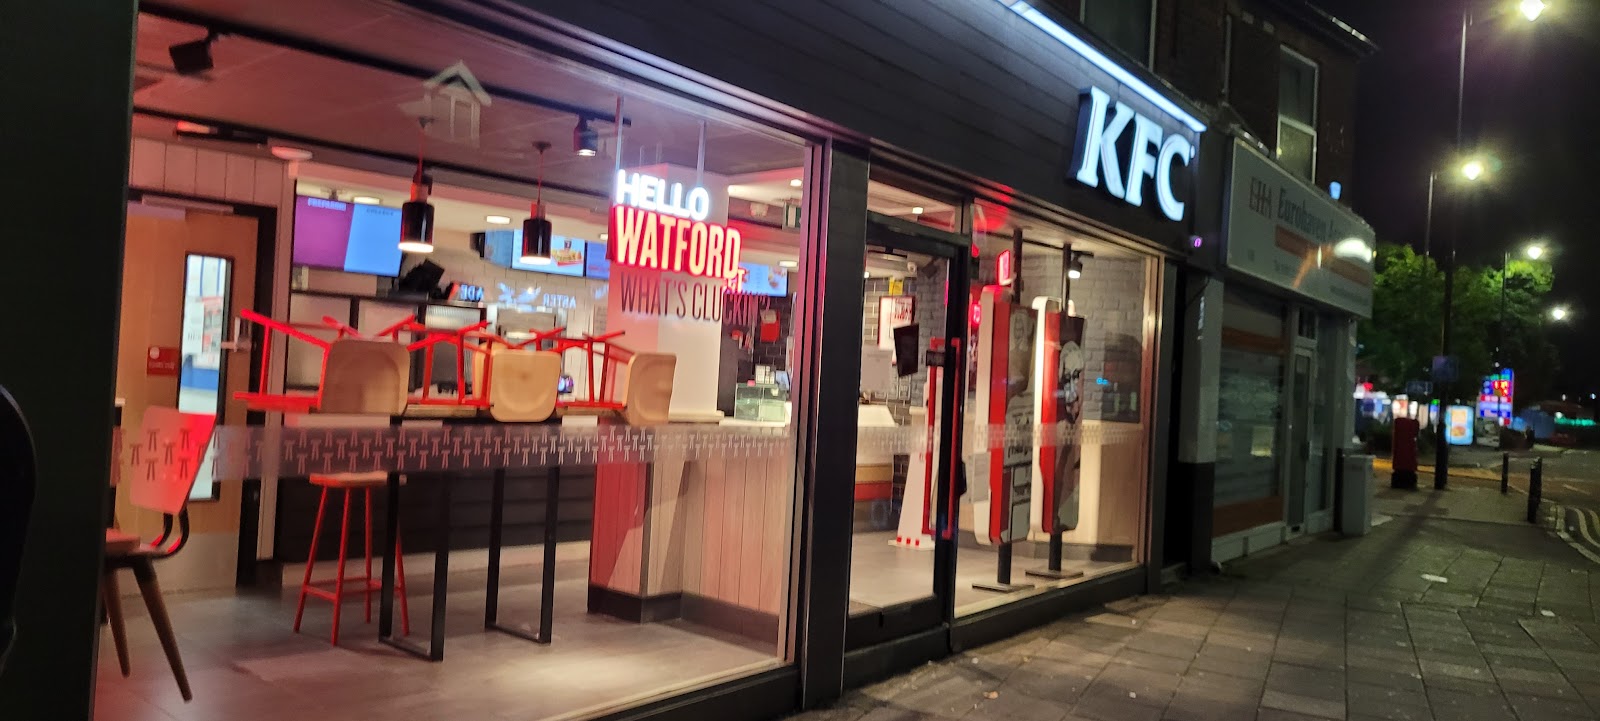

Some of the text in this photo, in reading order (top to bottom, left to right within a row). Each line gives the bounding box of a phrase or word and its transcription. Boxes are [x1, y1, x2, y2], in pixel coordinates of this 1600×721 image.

[1077, 85, 1191, 222] KFC
[616, 169, 710, 221] HELLO
[615, 206, 741, 279] WATFORD
[620, 271, 688, 319] WHAT'S
